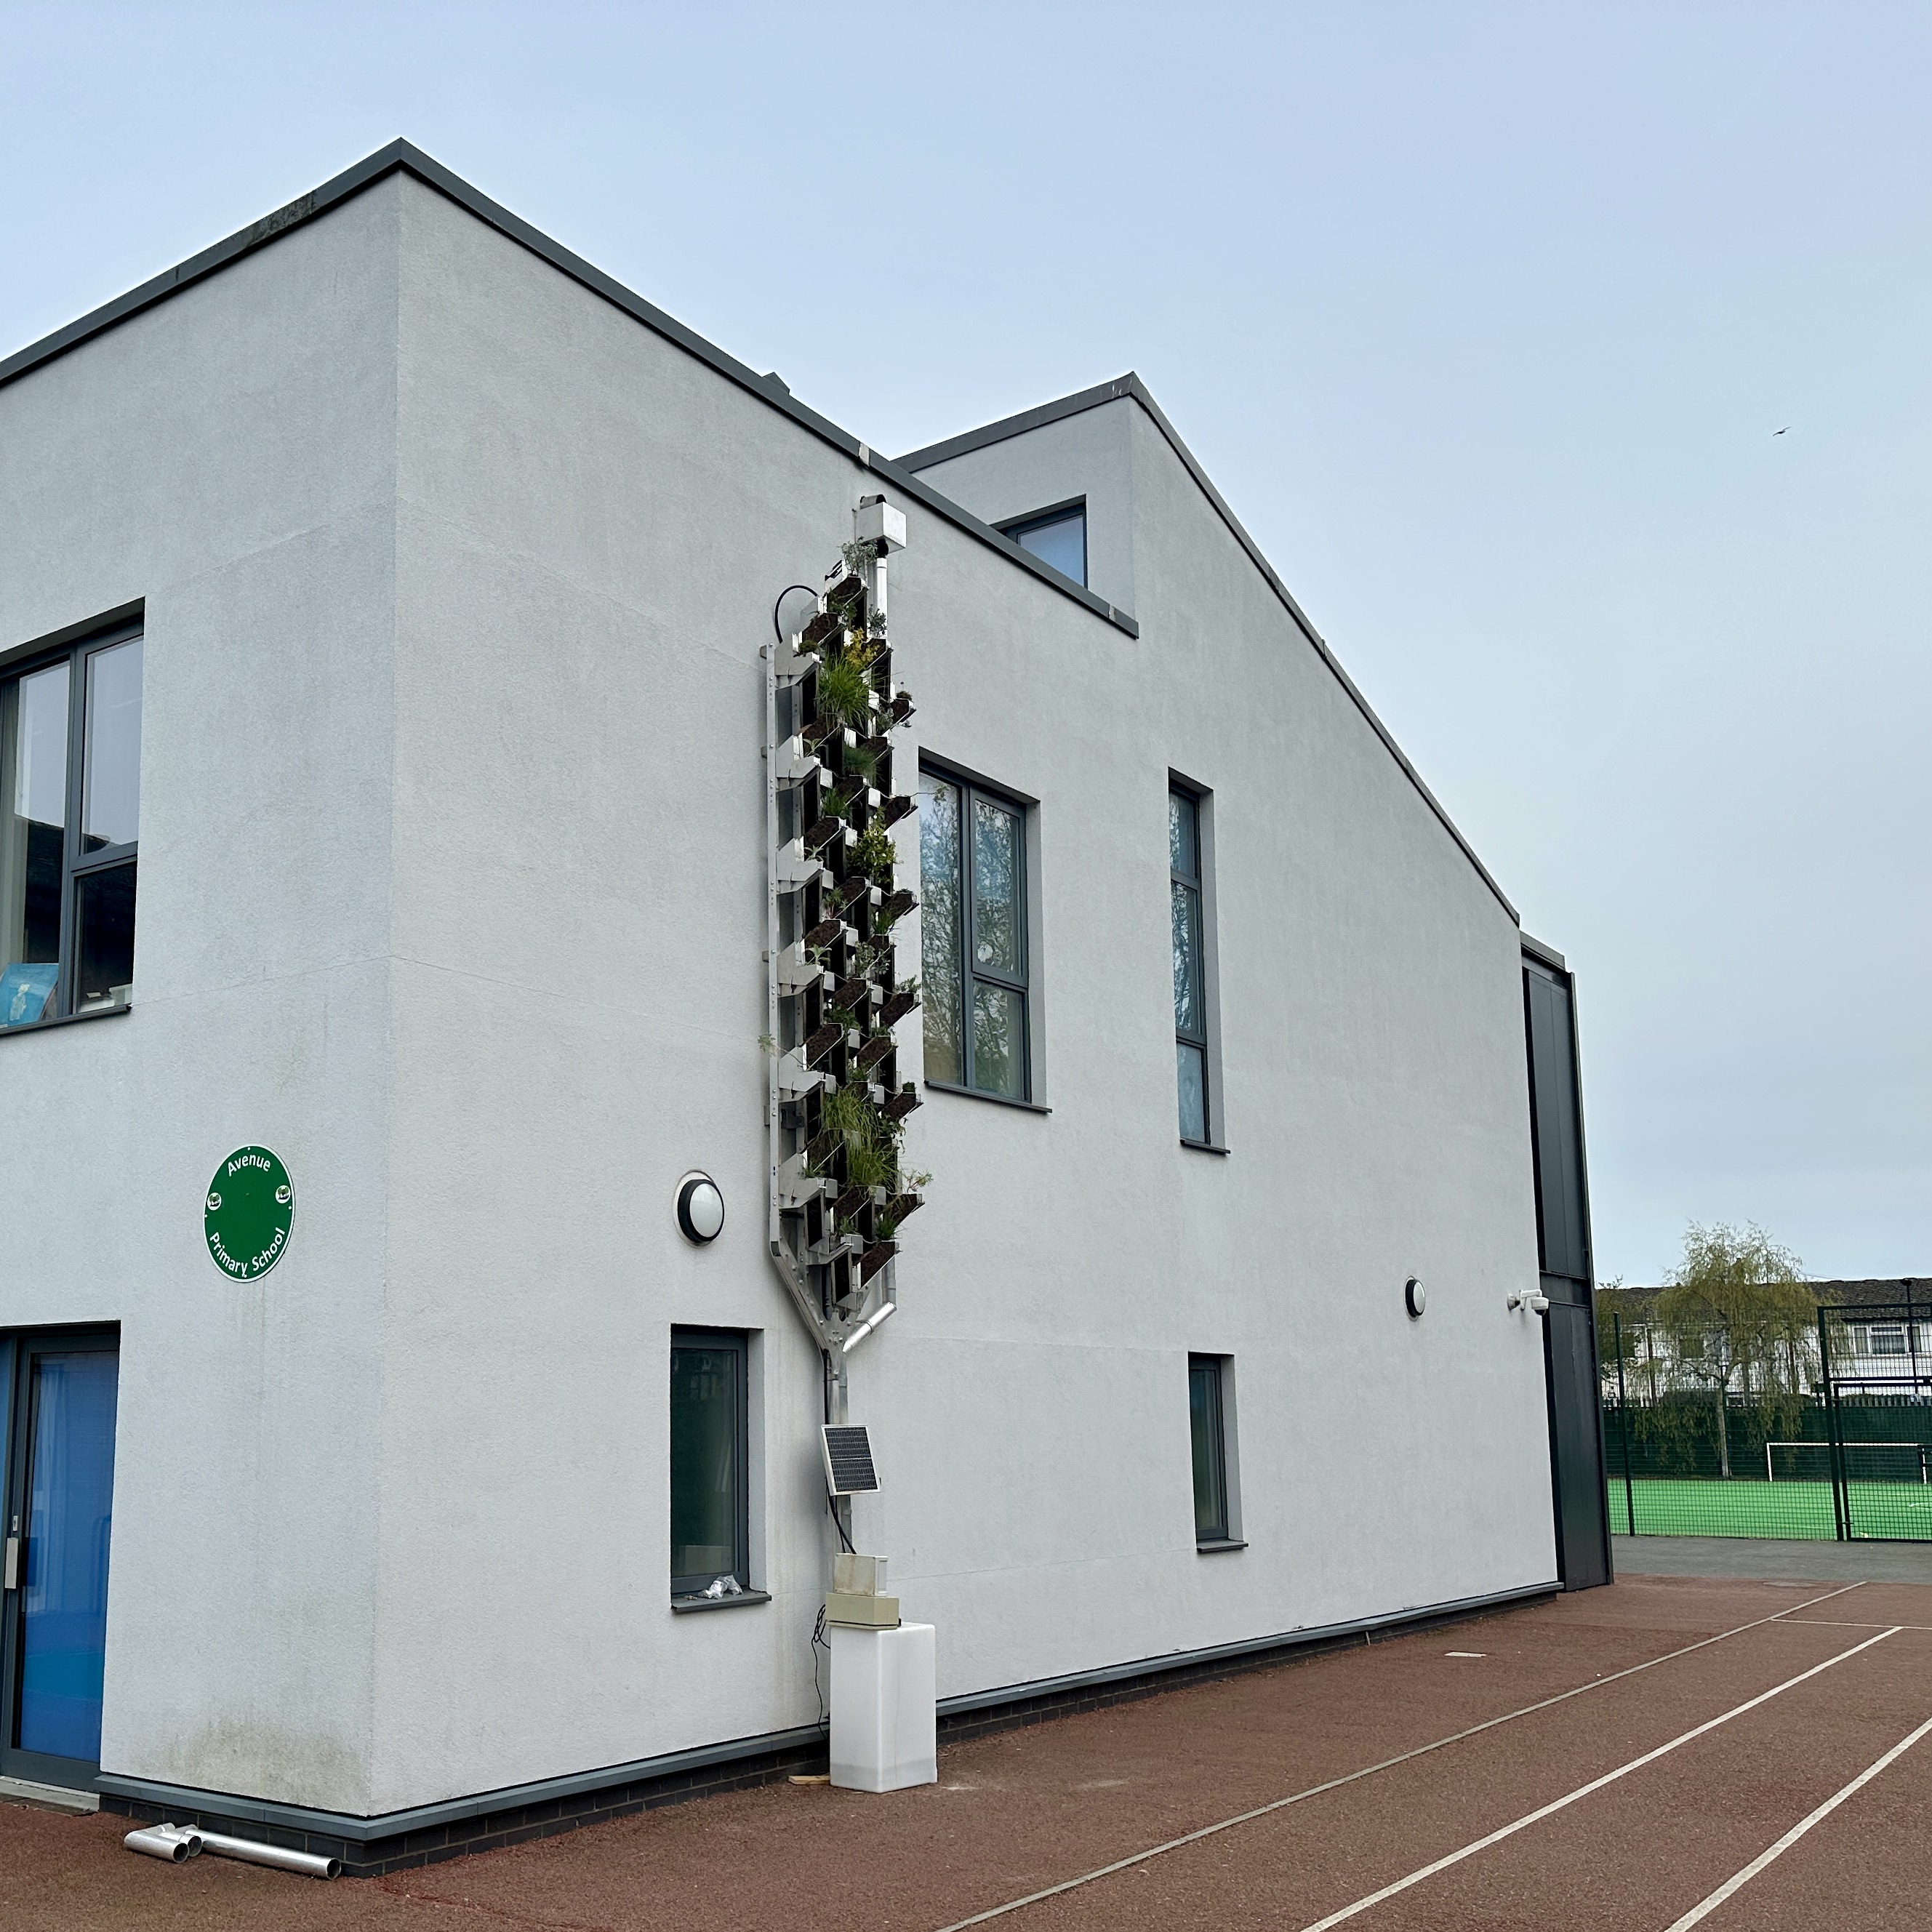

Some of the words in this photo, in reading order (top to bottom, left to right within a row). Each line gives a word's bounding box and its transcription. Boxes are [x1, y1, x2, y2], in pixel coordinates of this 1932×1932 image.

[227, 1155, 271, 1177] Avenue
[209, 1232, 248, 1277] Primary
[252, 1227, 285, 1271] School
